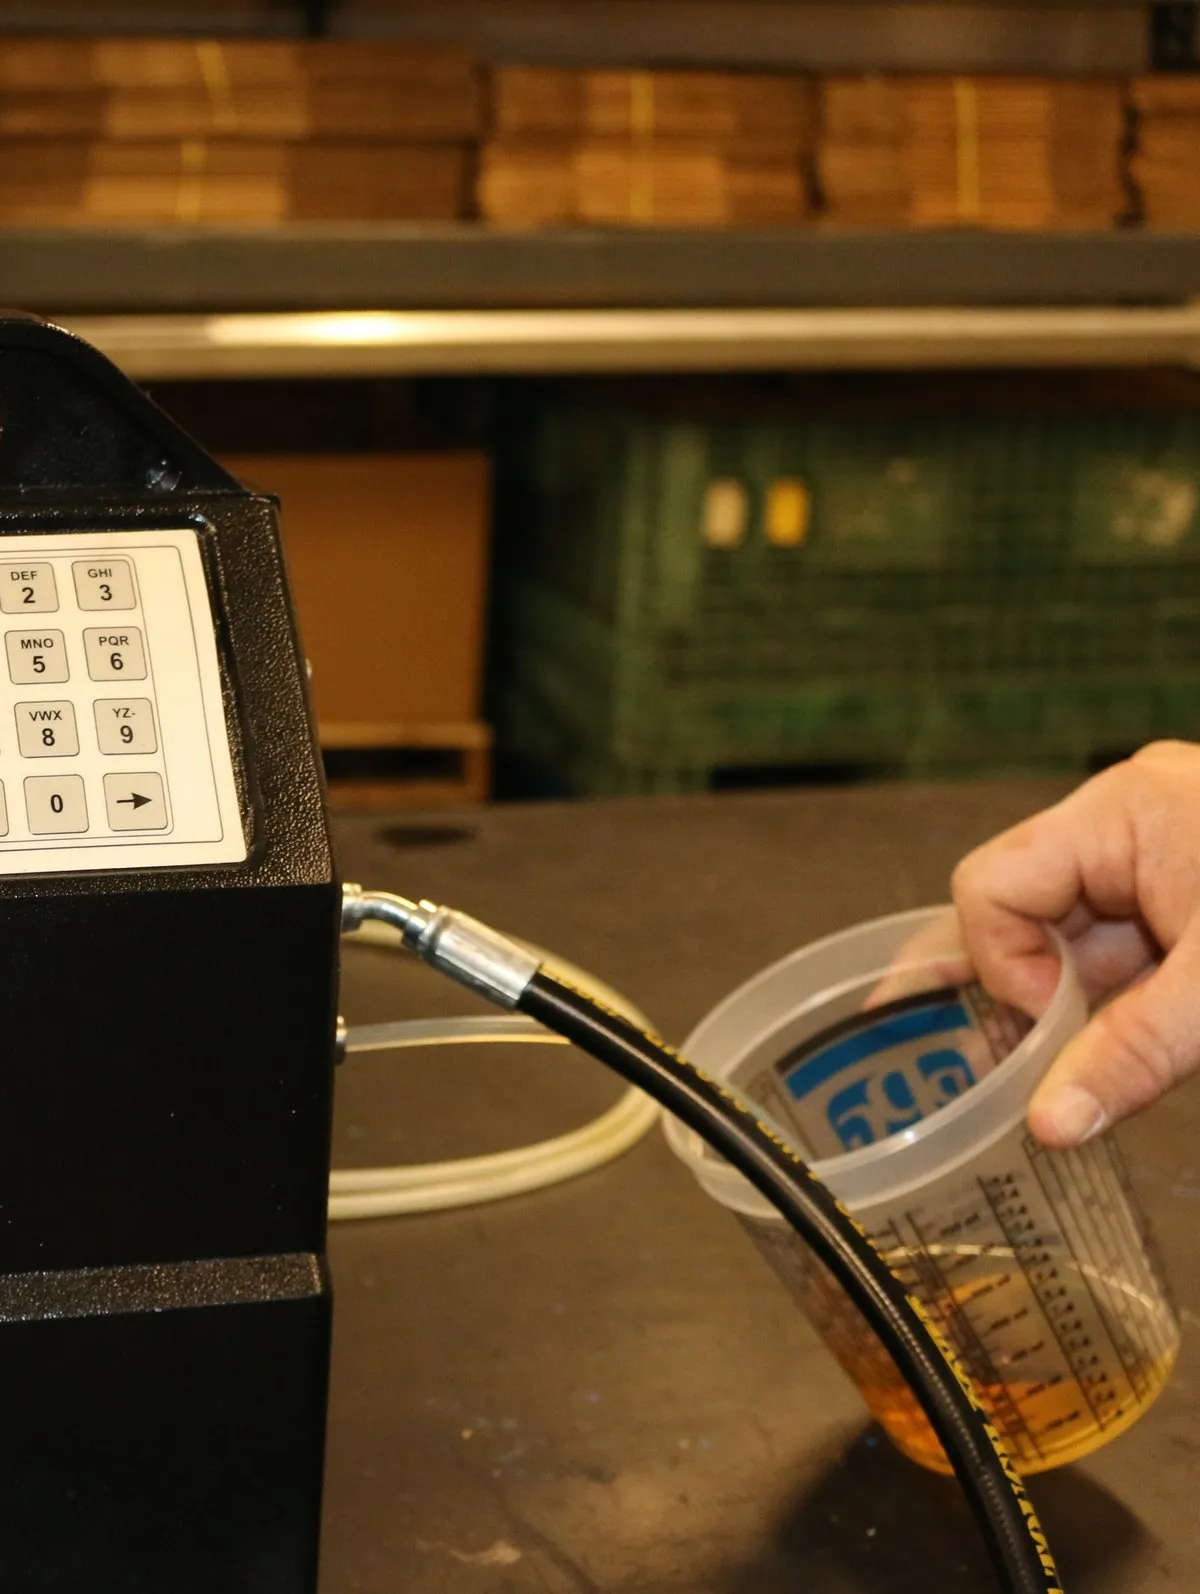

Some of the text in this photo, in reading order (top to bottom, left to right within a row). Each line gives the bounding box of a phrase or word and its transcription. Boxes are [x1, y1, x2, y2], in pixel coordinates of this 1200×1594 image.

[10, 570, 37, 581] DEF
[87, 568, 113, 579] GHI
[21, 586, 36, 604] 2
[99, 584, 113, 601] 3
[20, 638, 54, 649] MNO
[98, 635, 130, 647] PQR
[32, 655, 46, 674] 5
[110, 652, 124, 671] 6
[28, 710, 62, 722] VWX
[41, 727, 56, 747] 8
[119, 725, 134, 744] 9
[50, 794, 64, 814] 0
